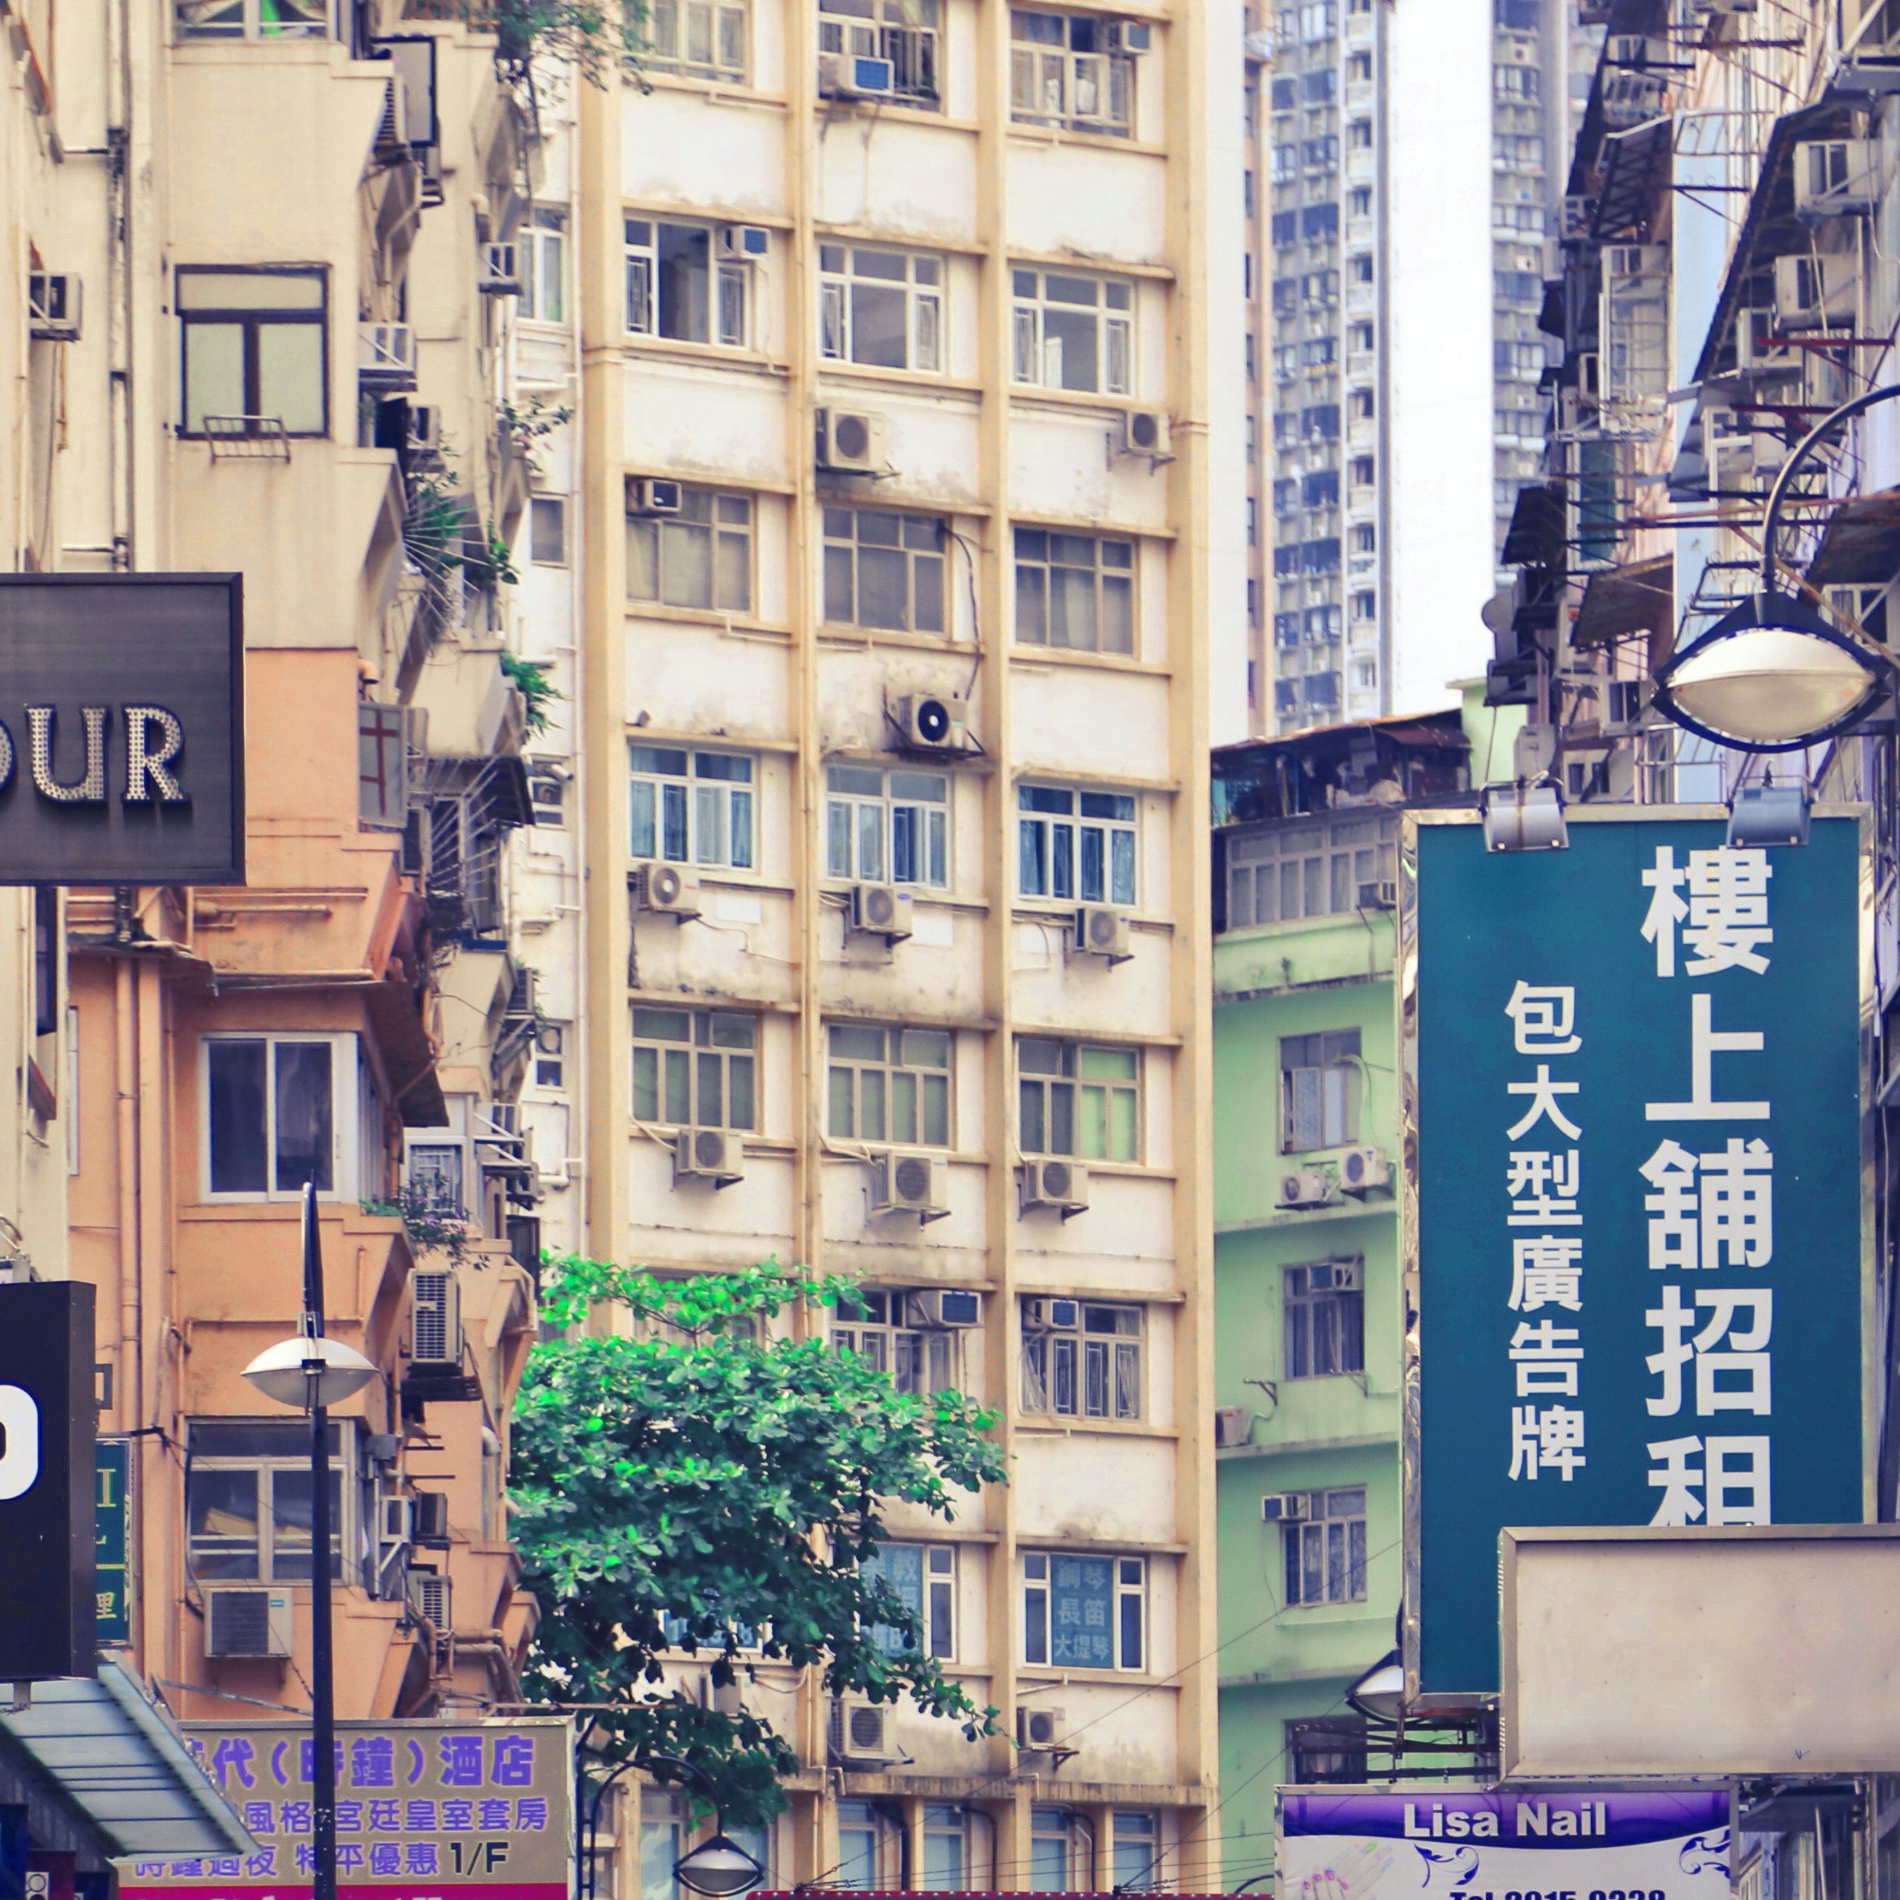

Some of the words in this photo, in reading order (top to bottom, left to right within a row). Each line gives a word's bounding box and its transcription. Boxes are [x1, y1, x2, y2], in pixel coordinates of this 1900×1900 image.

[1504, 980, 1586, 1483] 包大型廣告牌
[1404, 1802, 1500, 1838] Lisa
[1516, 1802, 1607, 1837] Nail
[449, 1841, 510, 1875] 1/F
